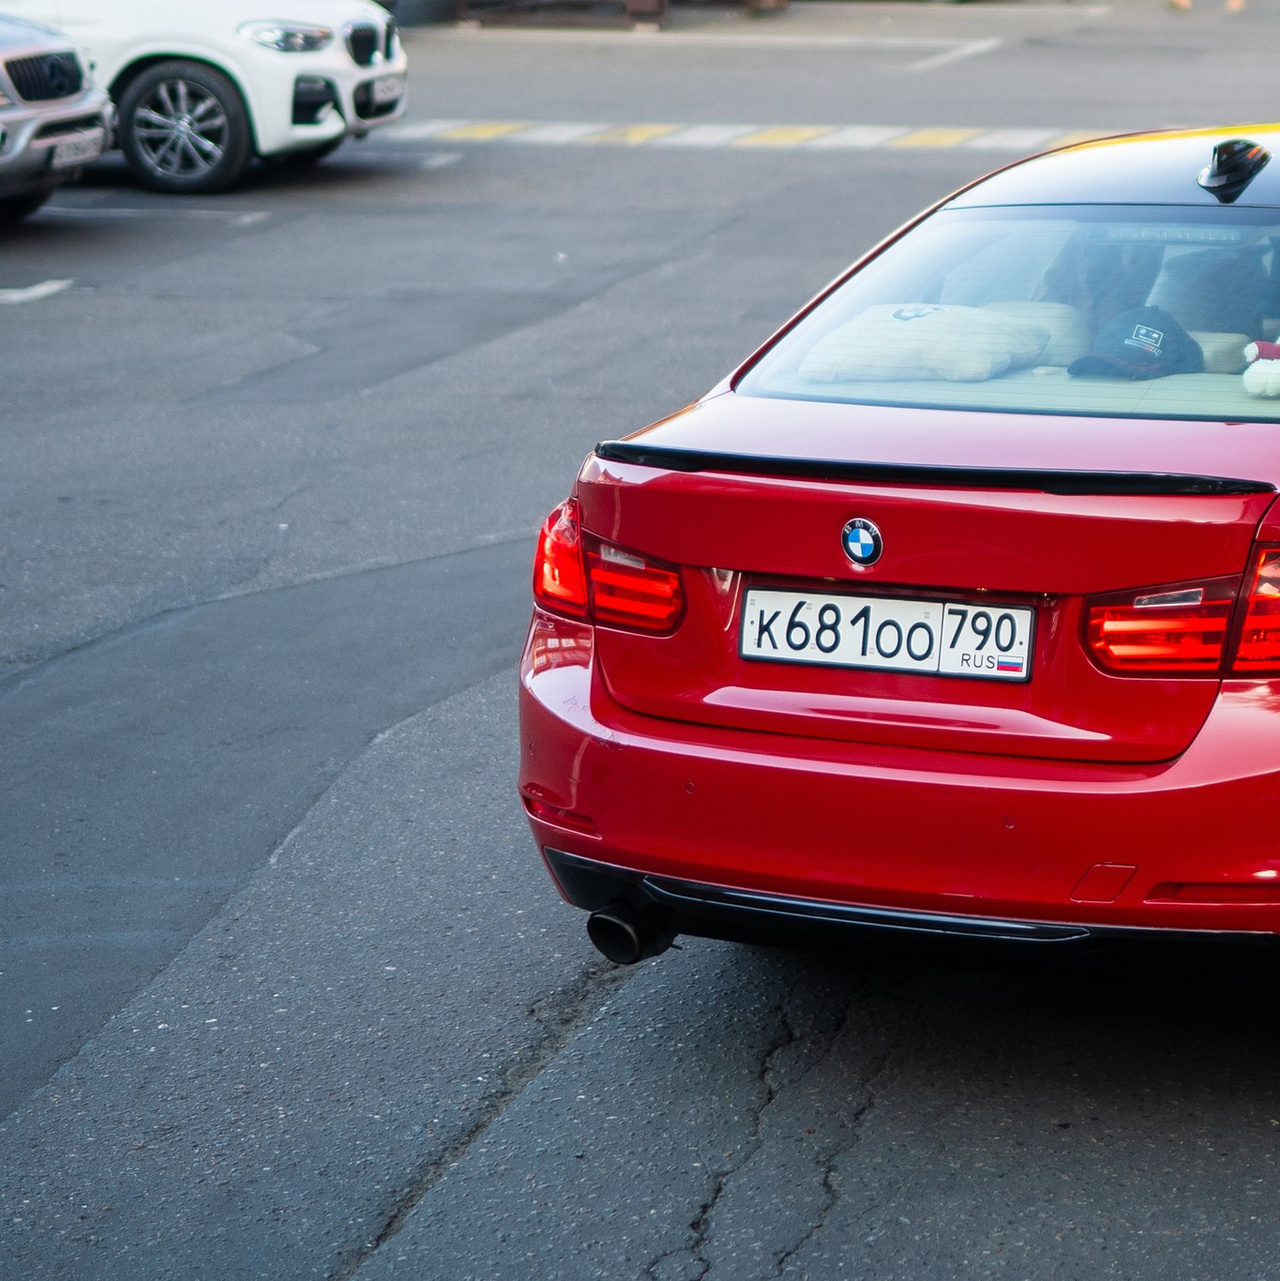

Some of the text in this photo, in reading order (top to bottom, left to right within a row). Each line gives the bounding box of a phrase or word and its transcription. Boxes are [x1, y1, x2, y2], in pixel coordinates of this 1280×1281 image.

[845, 520, 878, 536] BMW
[948, 608, 1017, 652] 790
[961, 653, 995, 669] RUS
